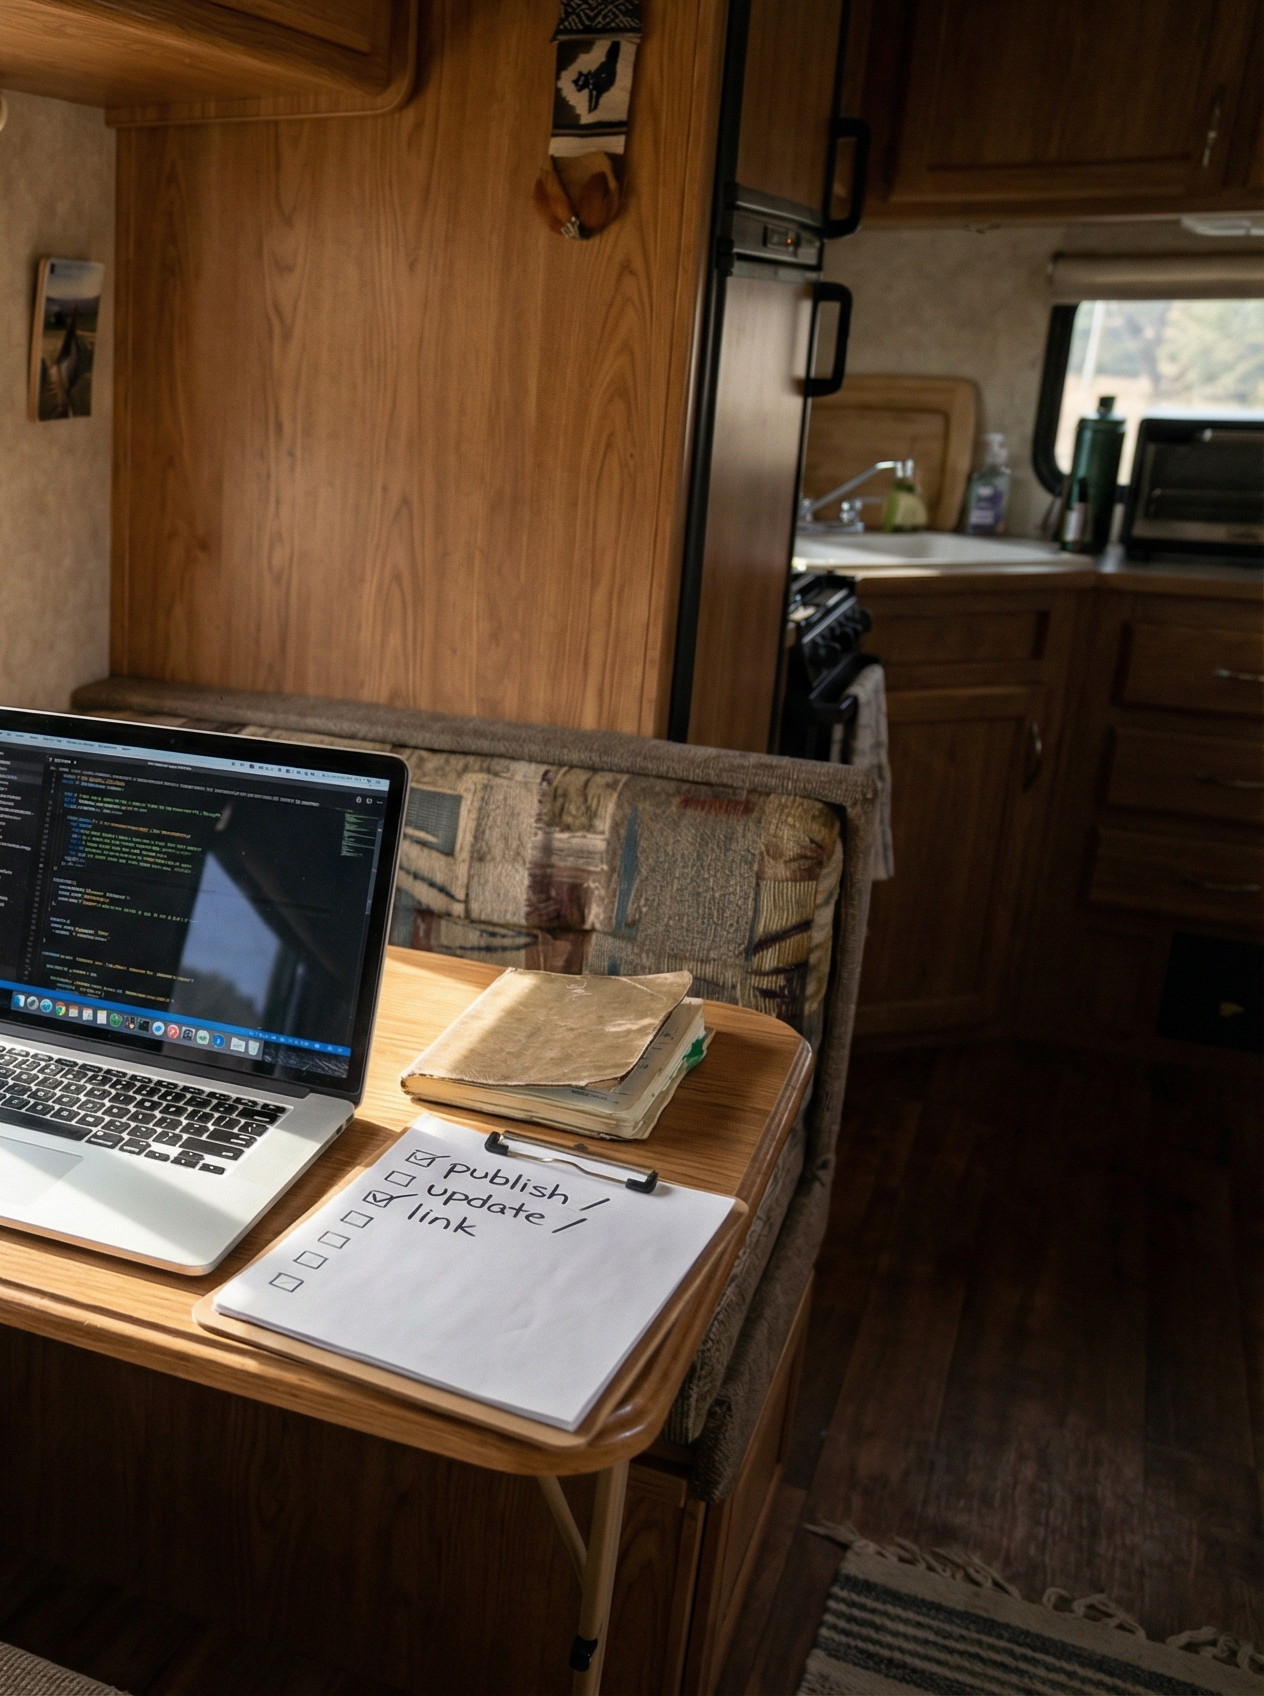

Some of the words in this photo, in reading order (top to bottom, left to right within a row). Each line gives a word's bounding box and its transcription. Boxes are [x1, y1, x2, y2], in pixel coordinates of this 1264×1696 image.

[426, 1183, 546, 1226] update
[442, 1162, 569, 1205] publish
[407, 1202, 477, 1238] link
